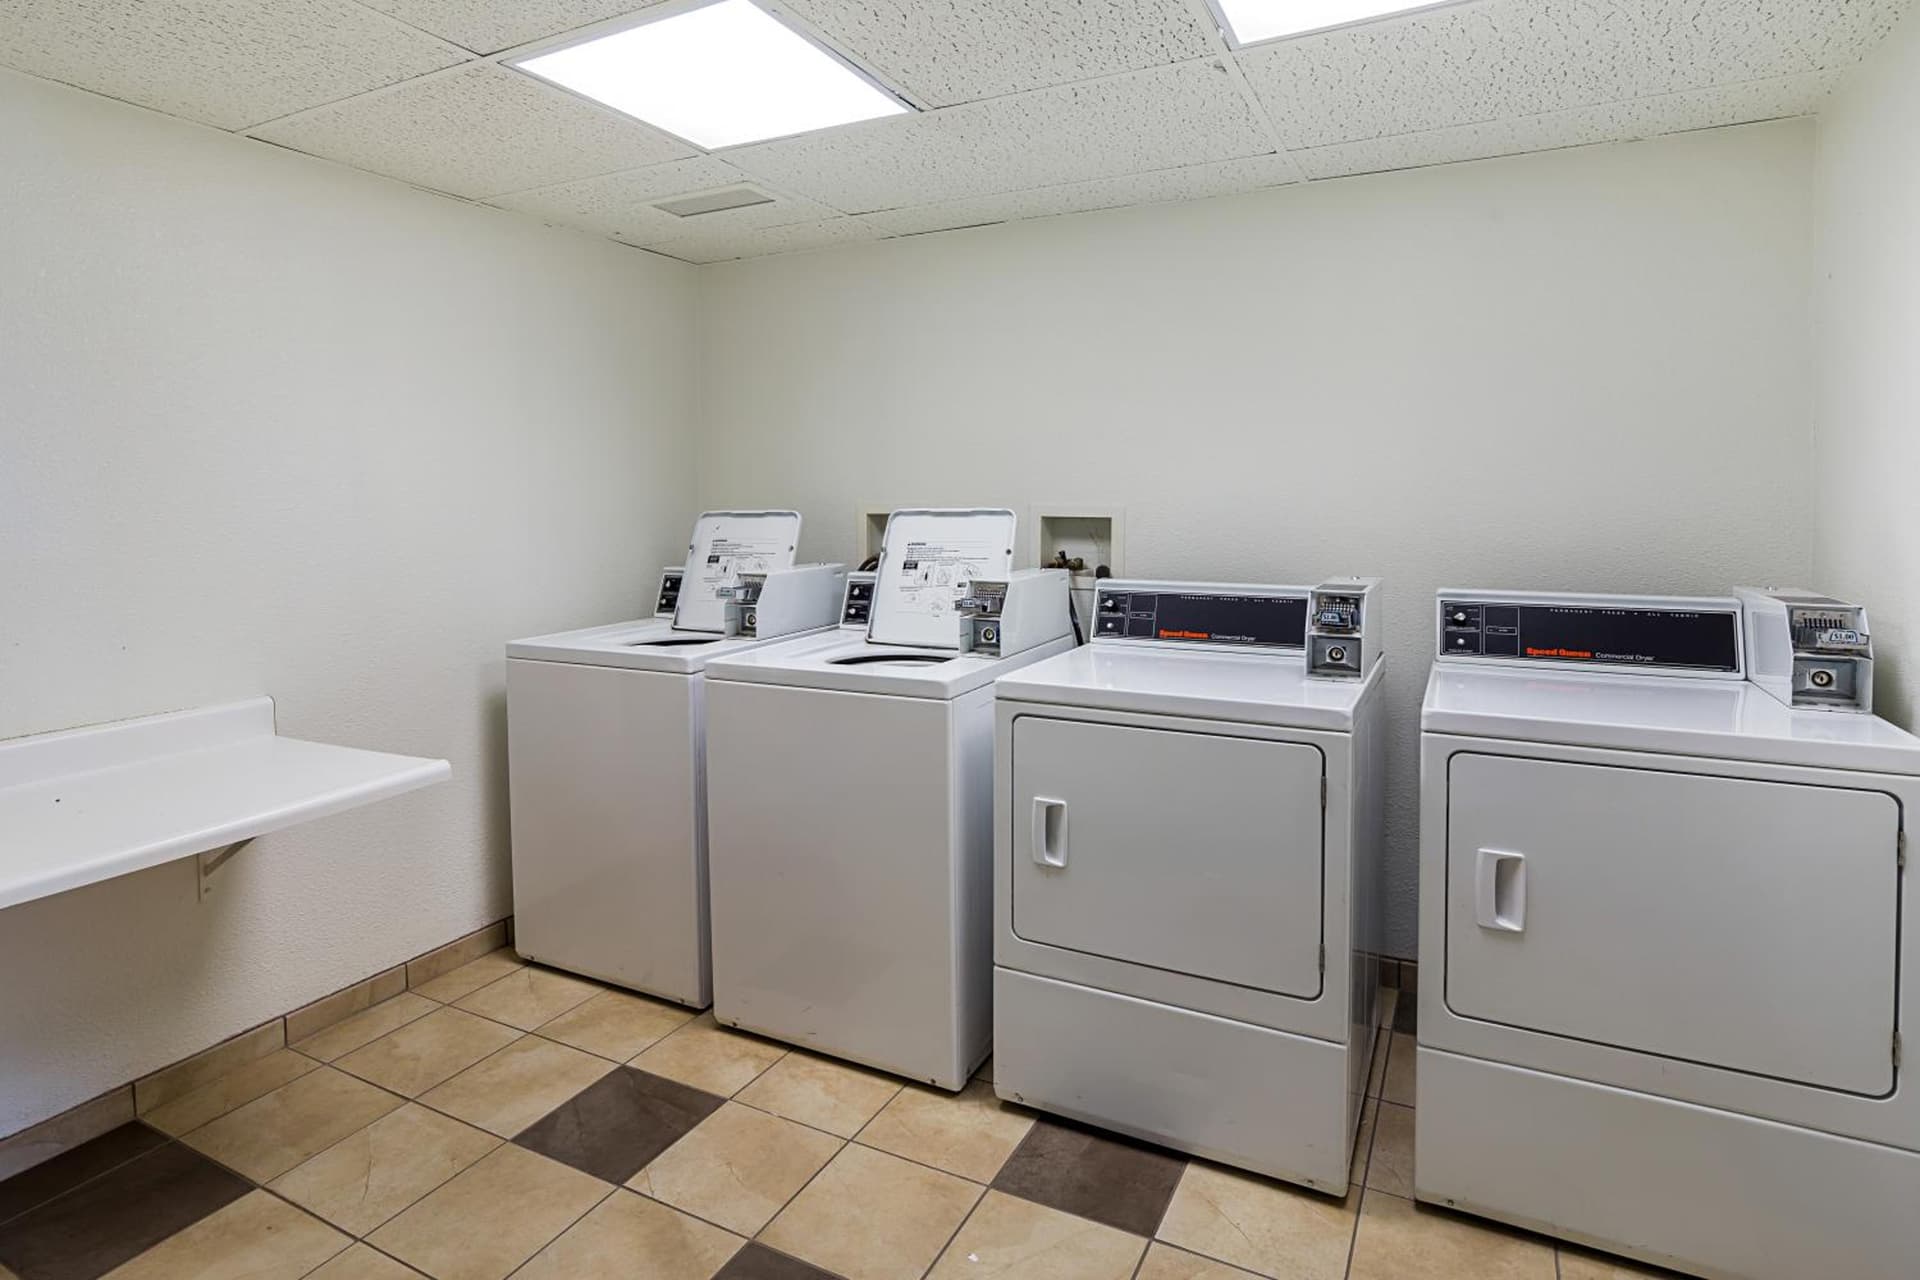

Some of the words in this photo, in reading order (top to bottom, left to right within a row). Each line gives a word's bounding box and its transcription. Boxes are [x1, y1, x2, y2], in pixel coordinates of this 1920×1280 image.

[1526, 646, 1558, 657] Speed
[1559, 649, 1591, 658] Queen
[1595, 651, 1634, 661] Commercial
[1635, 654, 1655, 662] Dryer
